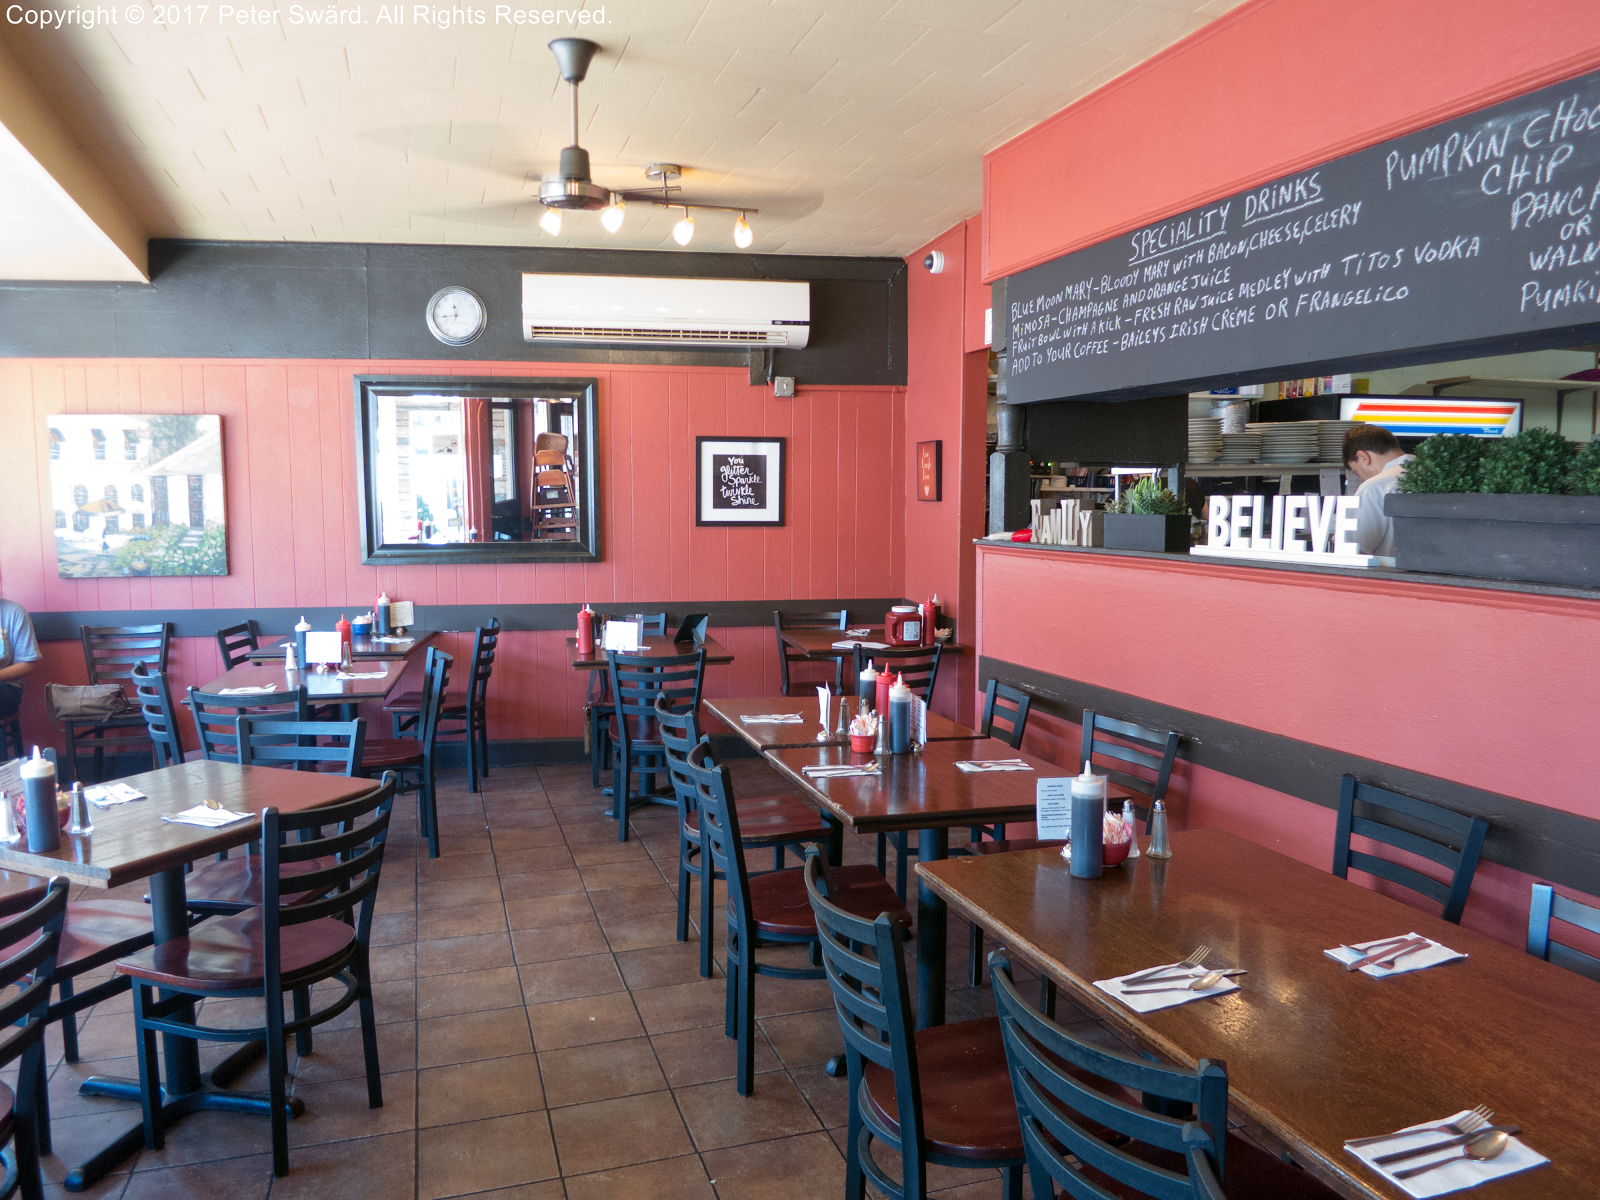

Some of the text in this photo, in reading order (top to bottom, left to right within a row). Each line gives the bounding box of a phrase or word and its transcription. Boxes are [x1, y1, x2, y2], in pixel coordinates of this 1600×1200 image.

[1385, 124, 1512, 191] PUMPKIN
[1480, 144, 1574, 195] CHIP
[1128, 171, 1322, 263] SPECIALITY DRINKS
[1559, 213, 1592, 241] OR
[1011, 300, 1034, 323] BLUE
[1036, 290, 1064, 313] MOON
[1143, 259, 1171, 283] MARY
[1172, 249, 1204, 276] WITH
[1012, 336, 1036, 357] FRUIT
[1037, 327, 1062, 345] BOWL
[1063, 321, 1089, 339] WITH
[1090, 321, 1096, 335] A
[1098, 315, 1121, 334] KICK
[1134, 299, 1170, 327] FRESH
[1173, 295, 1199, 316] RAW
[1200, 288, 1235, 309] JUICE
[1238, 267, 1292, 299] MEDLEY
[1294, 263, 1331, 287] WITH
[1341, 247, 1405, 277] TITOS
[1414, 235, 1481, 265] VODKA
[1122, 288, 1146, 309] AND
[1146, 278, 1188, 301] ORANGE
[1190, 266, 1231, 290] JUICE
[1011, 355, 1031, 376] ADD
[1032, 352, 1042, 367] TO
[1046, 342, 1072, 365] YOUR
[1073, 338, 1109, 359] COFFEE
[1169, 316, 1209, 339] IRISH
[1264, 297, 1289, 321] OR
[1294, 285, 1410, 318] FRANGELICO
[720, 464, 754, 483] glitter
[727, 456, 745, 466] You
[720, 484, 755, 499] twinkle
[1207, 494, 1361, 556] BELIEVE
